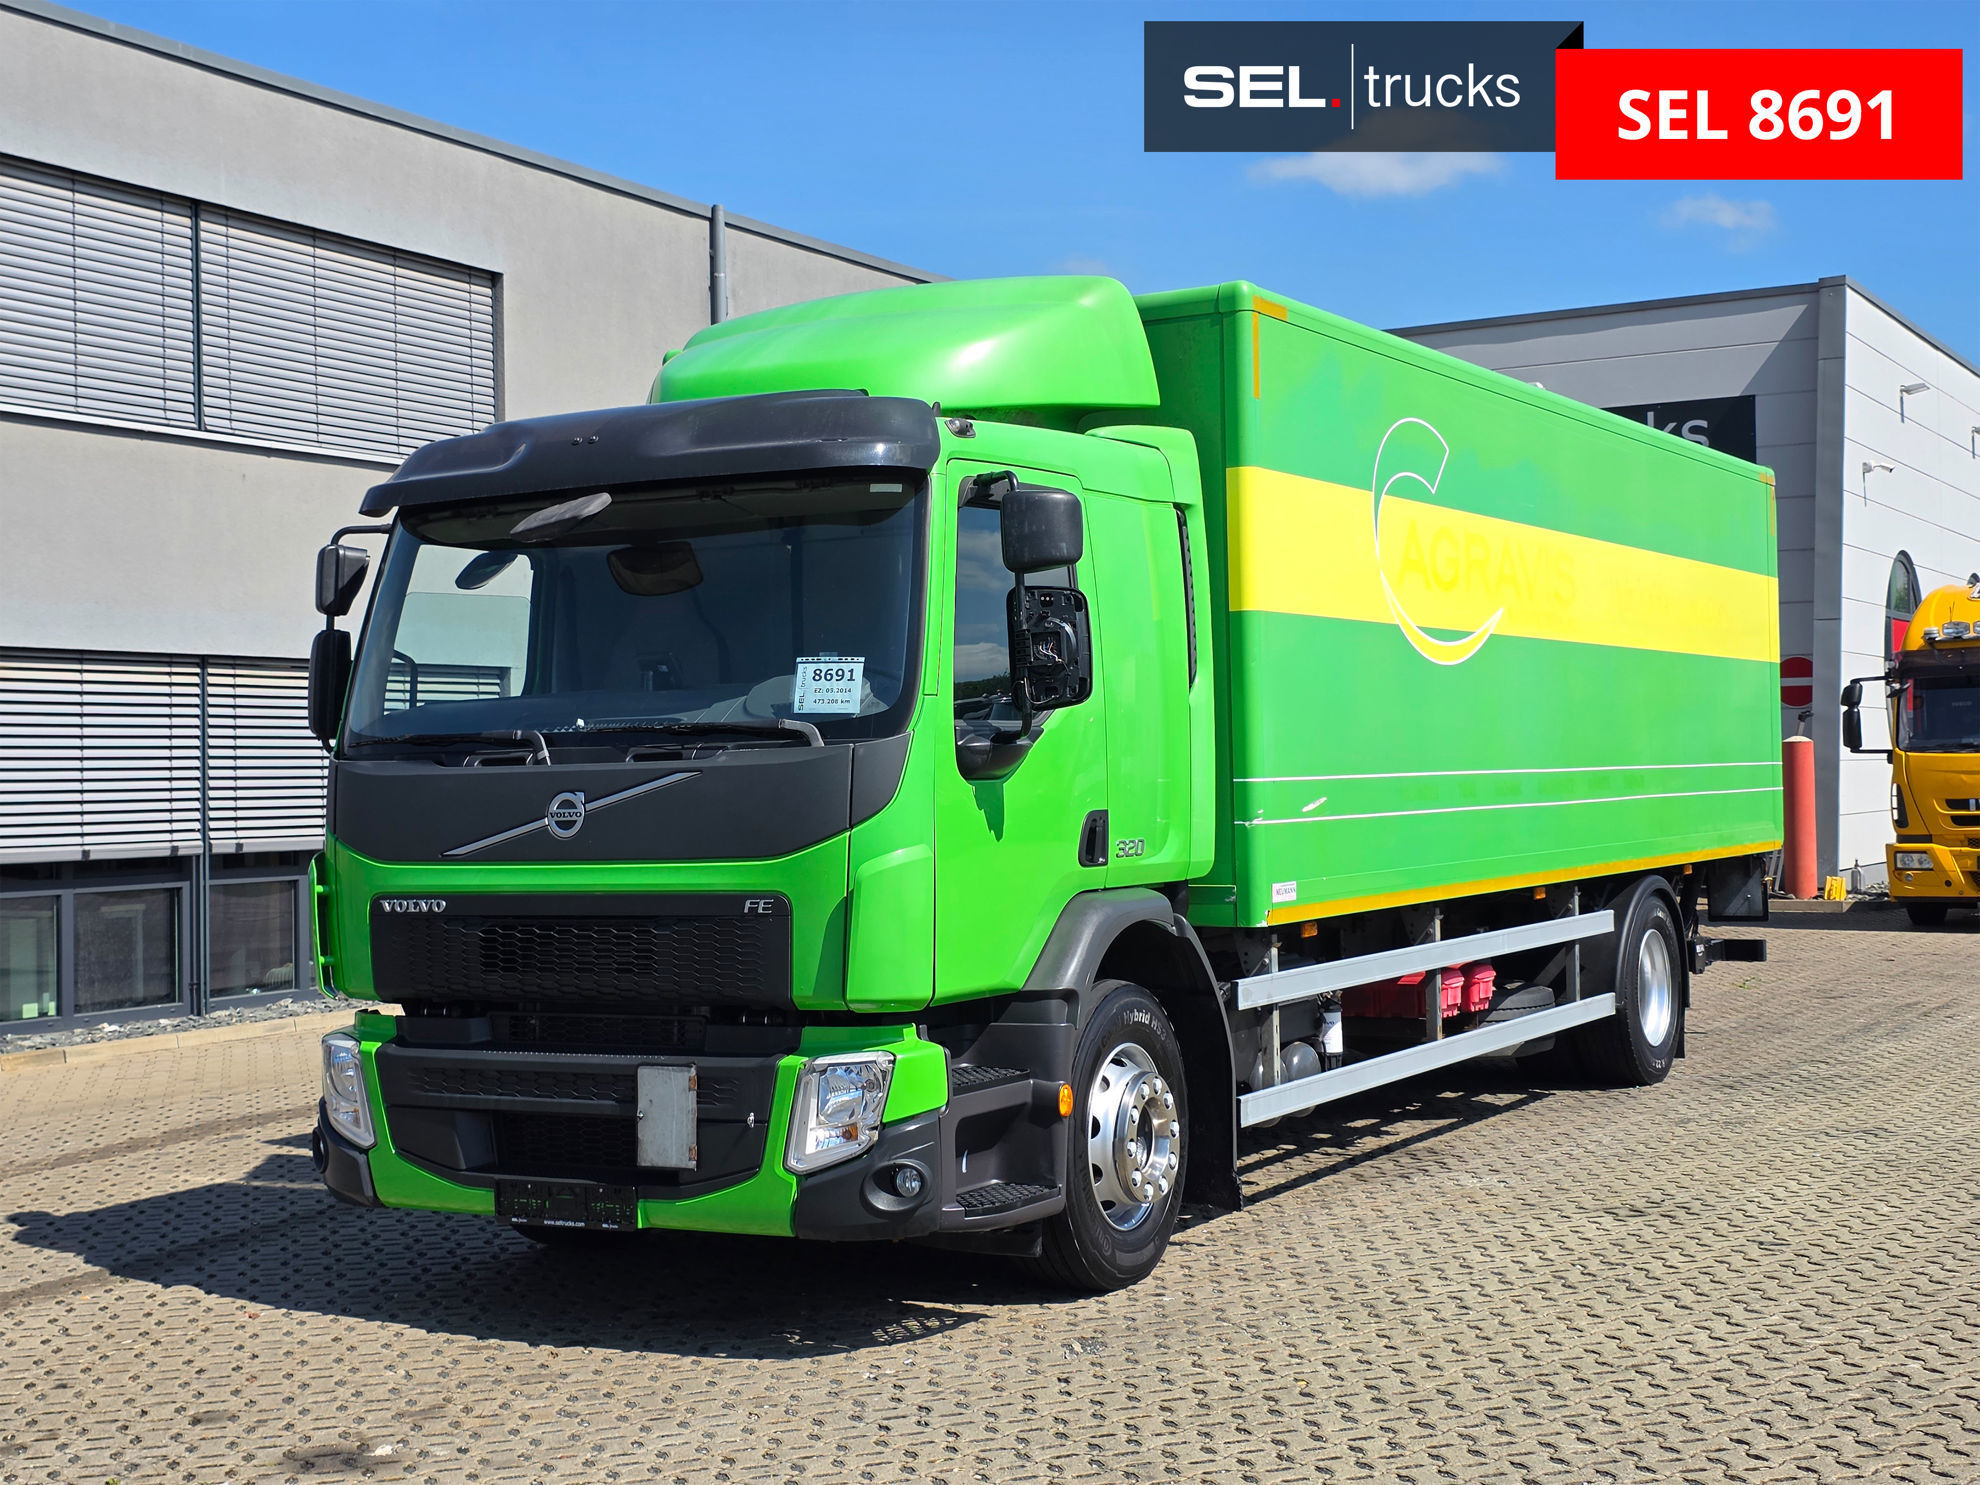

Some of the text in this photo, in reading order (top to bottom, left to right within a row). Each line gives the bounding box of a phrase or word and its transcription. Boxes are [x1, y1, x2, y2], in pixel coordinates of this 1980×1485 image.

[1396, 518, 1577, 608] AGRAVIS
[812, 668, 856, 682] 8691
[549, 811, 583, 819] VOLVO
[1115, 838, 1145, 859] 320
[379, 899, 447, 913] VOLVO
[743, 899, 774, 913] FE
[1123, 1008, 1151, 1025] Hybrid
